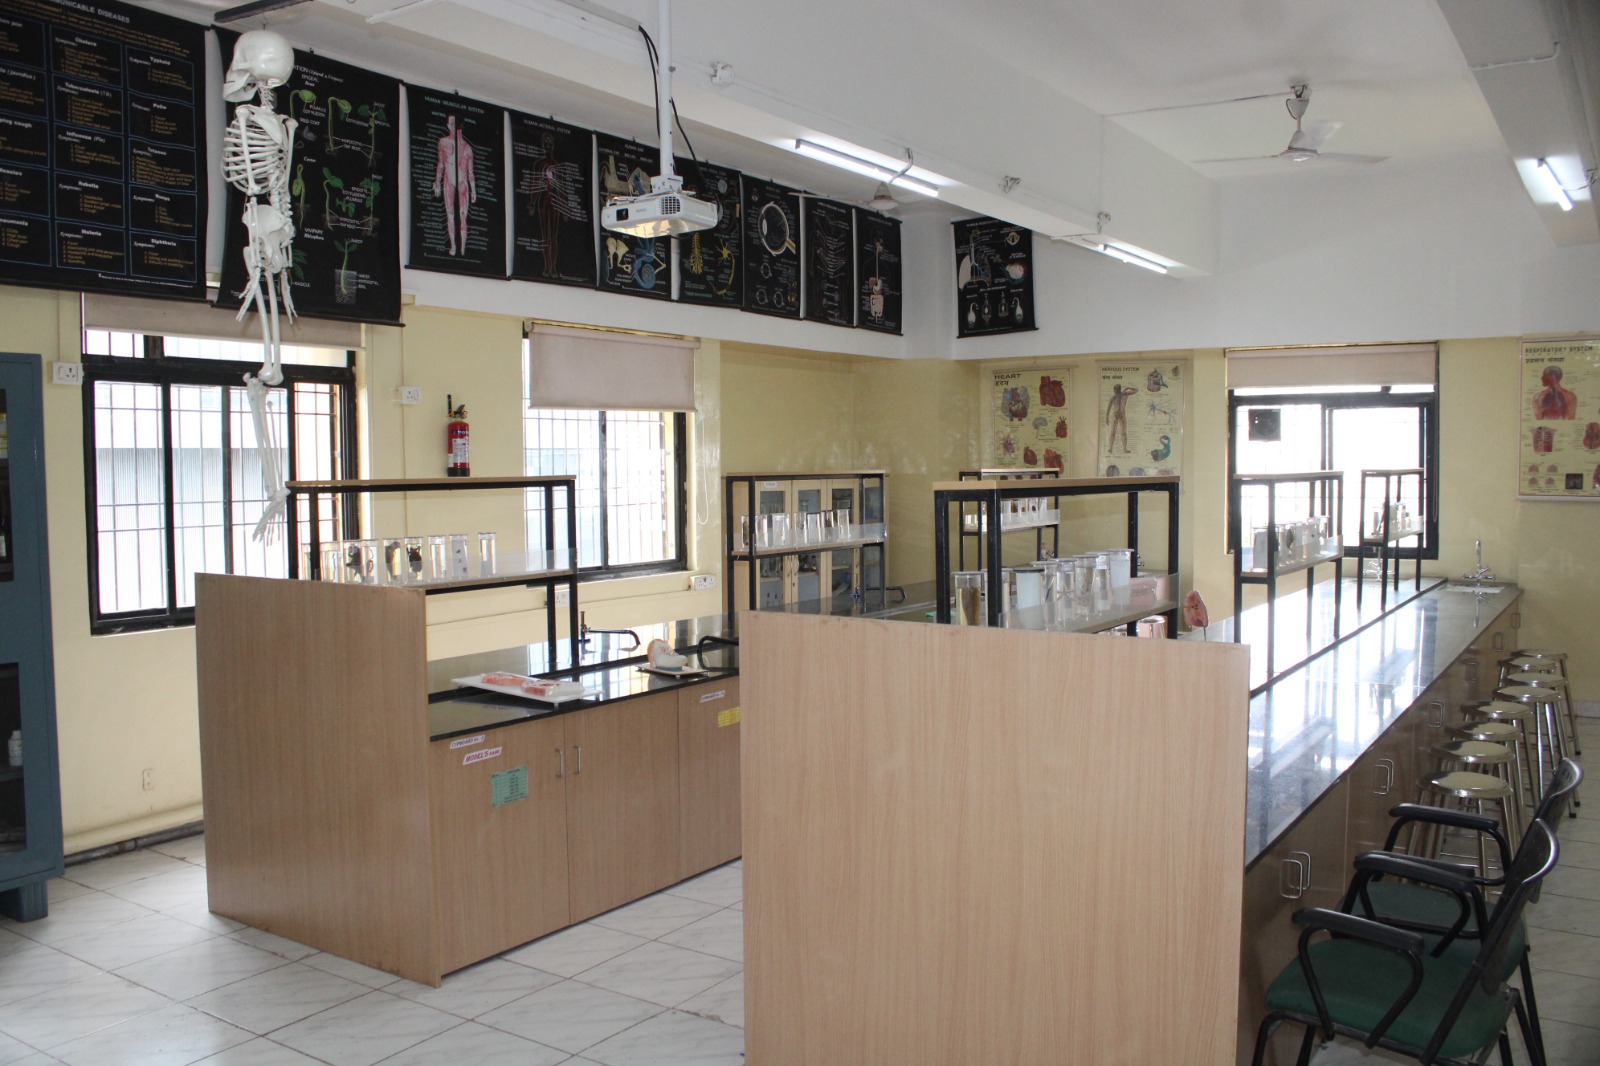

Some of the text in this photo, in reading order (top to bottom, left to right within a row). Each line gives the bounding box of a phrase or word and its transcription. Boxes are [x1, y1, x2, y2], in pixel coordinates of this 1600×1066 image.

[97, 8, 130, 24] DISEASES
[0, 218, 28, 226] neumonia
[466, 750, 488, 763] MODEL'S
